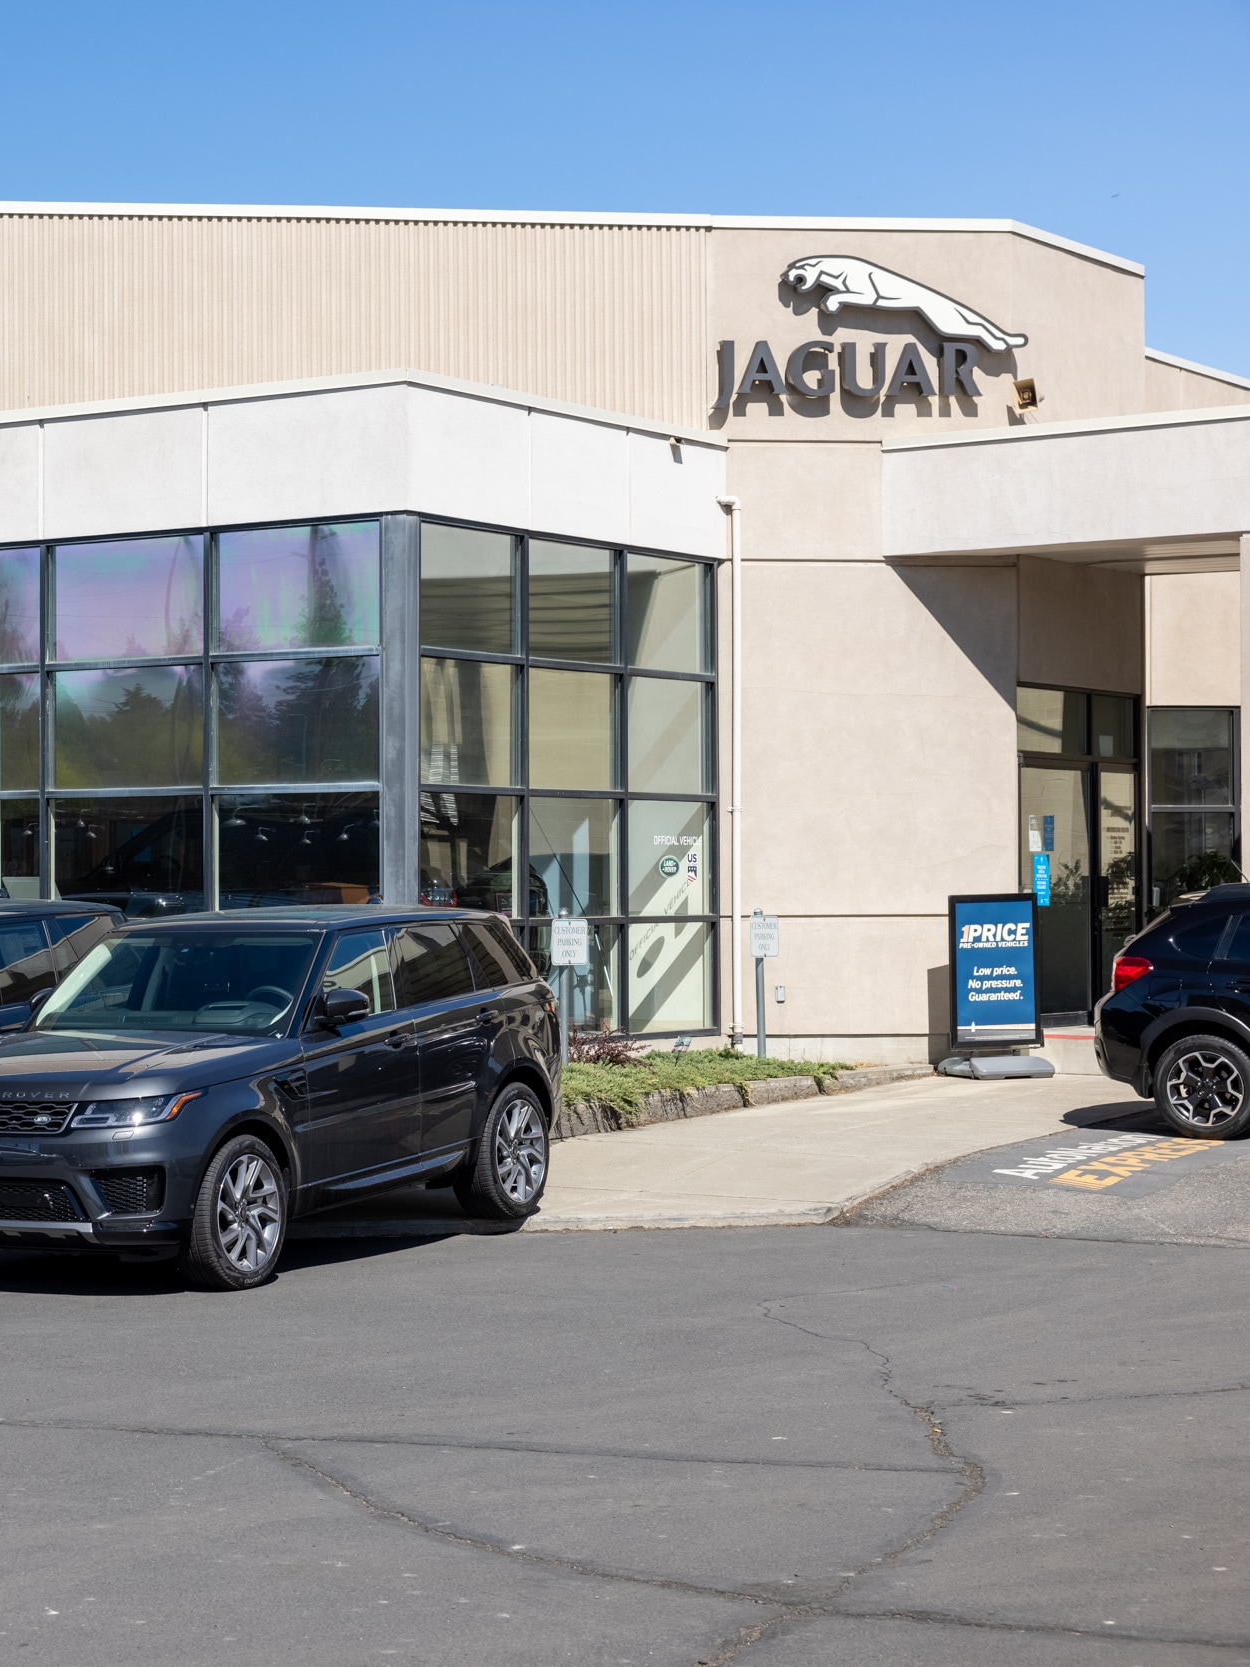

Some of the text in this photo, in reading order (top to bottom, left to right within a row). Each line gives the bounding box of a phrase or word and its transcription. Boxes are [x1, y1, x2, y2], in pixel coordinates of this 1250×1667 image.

[710, 339, 984, 410] JAGUAR
[653, 835, 679, 845] OFFICIAL
[687, 853, 697, 862] US
[754, 933, 774, 941] PARKING
[557, 938, 582, 946] PARKING
[998, 940, 1028, 948] VEHICLES
[561, 949, 576, 957] ONLY
[973, 965, 1017, 977] Low price.
[968, 979, 1023, 990] No pressure.
[1049, 1136, 1226, 1190] EXPRESS
